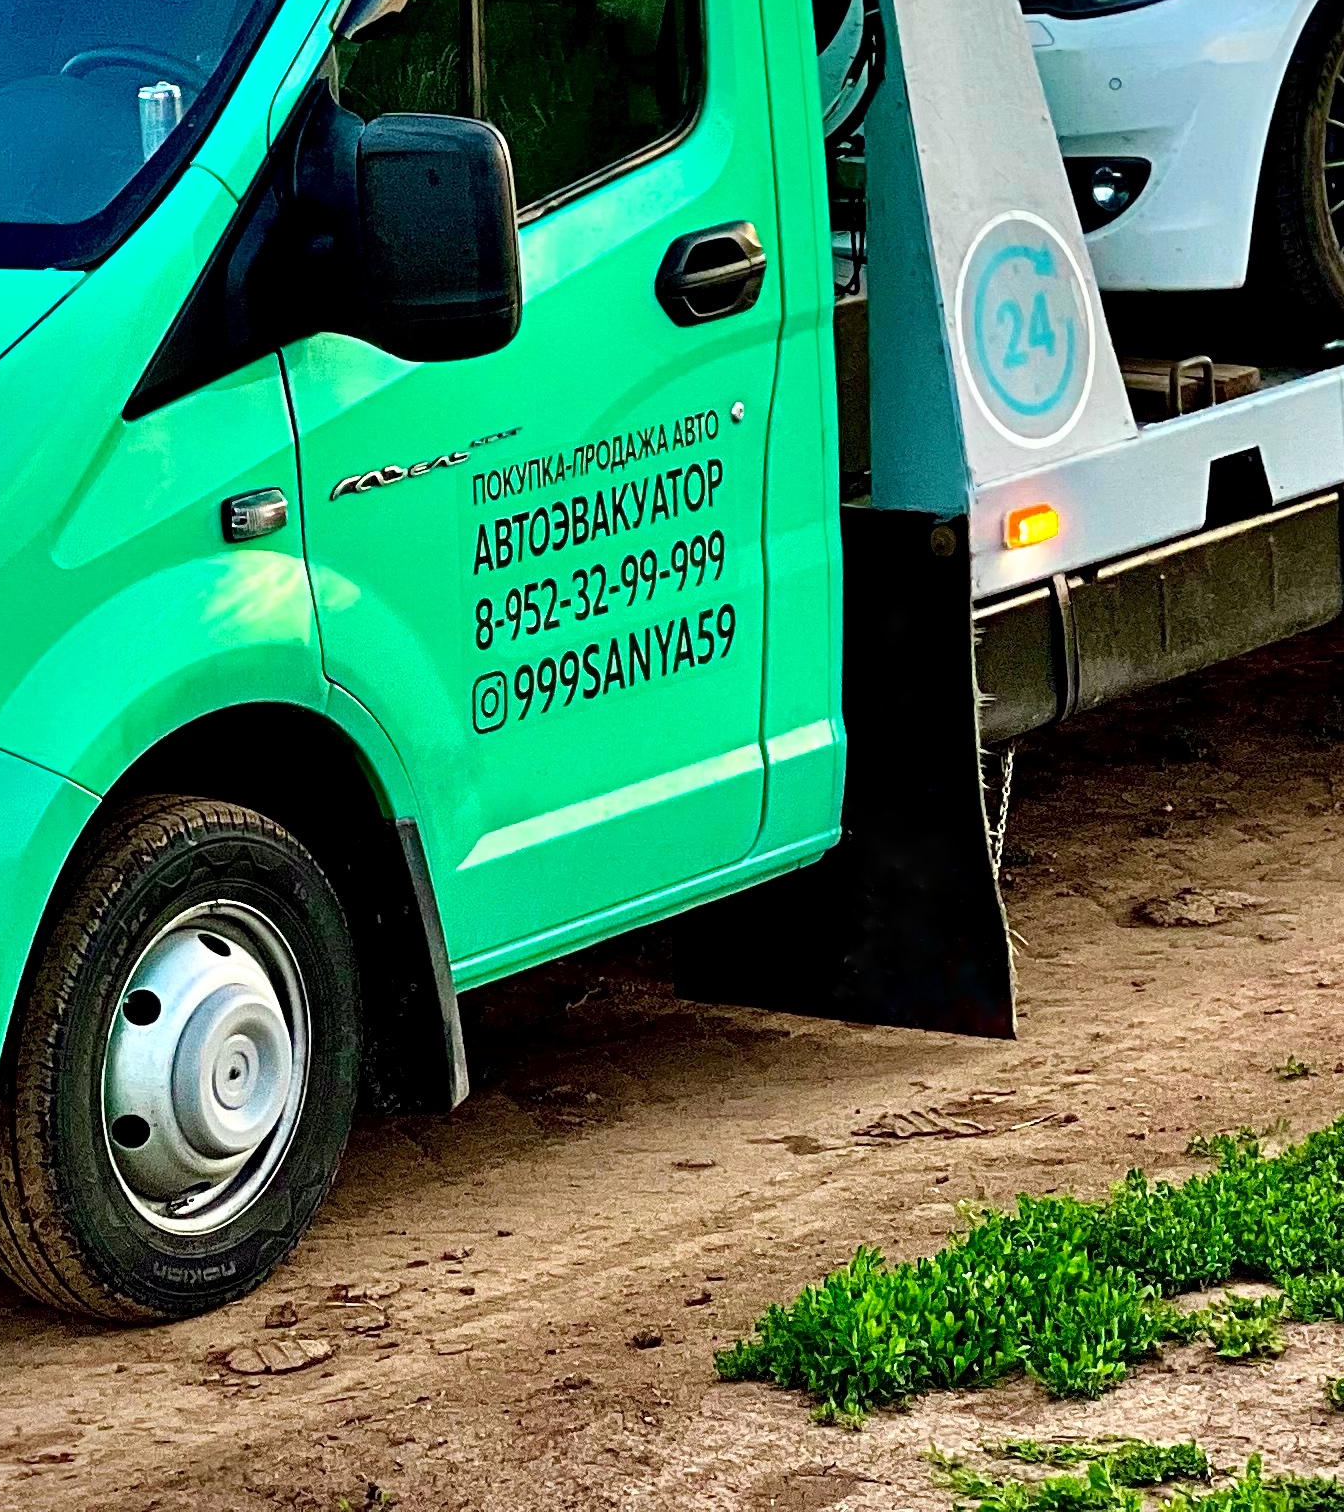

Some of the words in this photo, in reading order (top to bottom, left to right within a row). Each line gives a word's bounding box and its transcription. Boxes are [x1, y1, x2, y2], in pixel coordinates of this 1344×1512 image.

[995, 290, 1056, 369] 24
[472, 423, 669, 506] ПОКУПКА-ПРОДАЖА
[671, 409, 720, 451] АВТО
[472, 458, 725, 576] АВТОЭВАКУАТОР
[474, 529, 726, 651] 8-952-32-99-999
[513, 602, 737, 722] 999SANYA59
